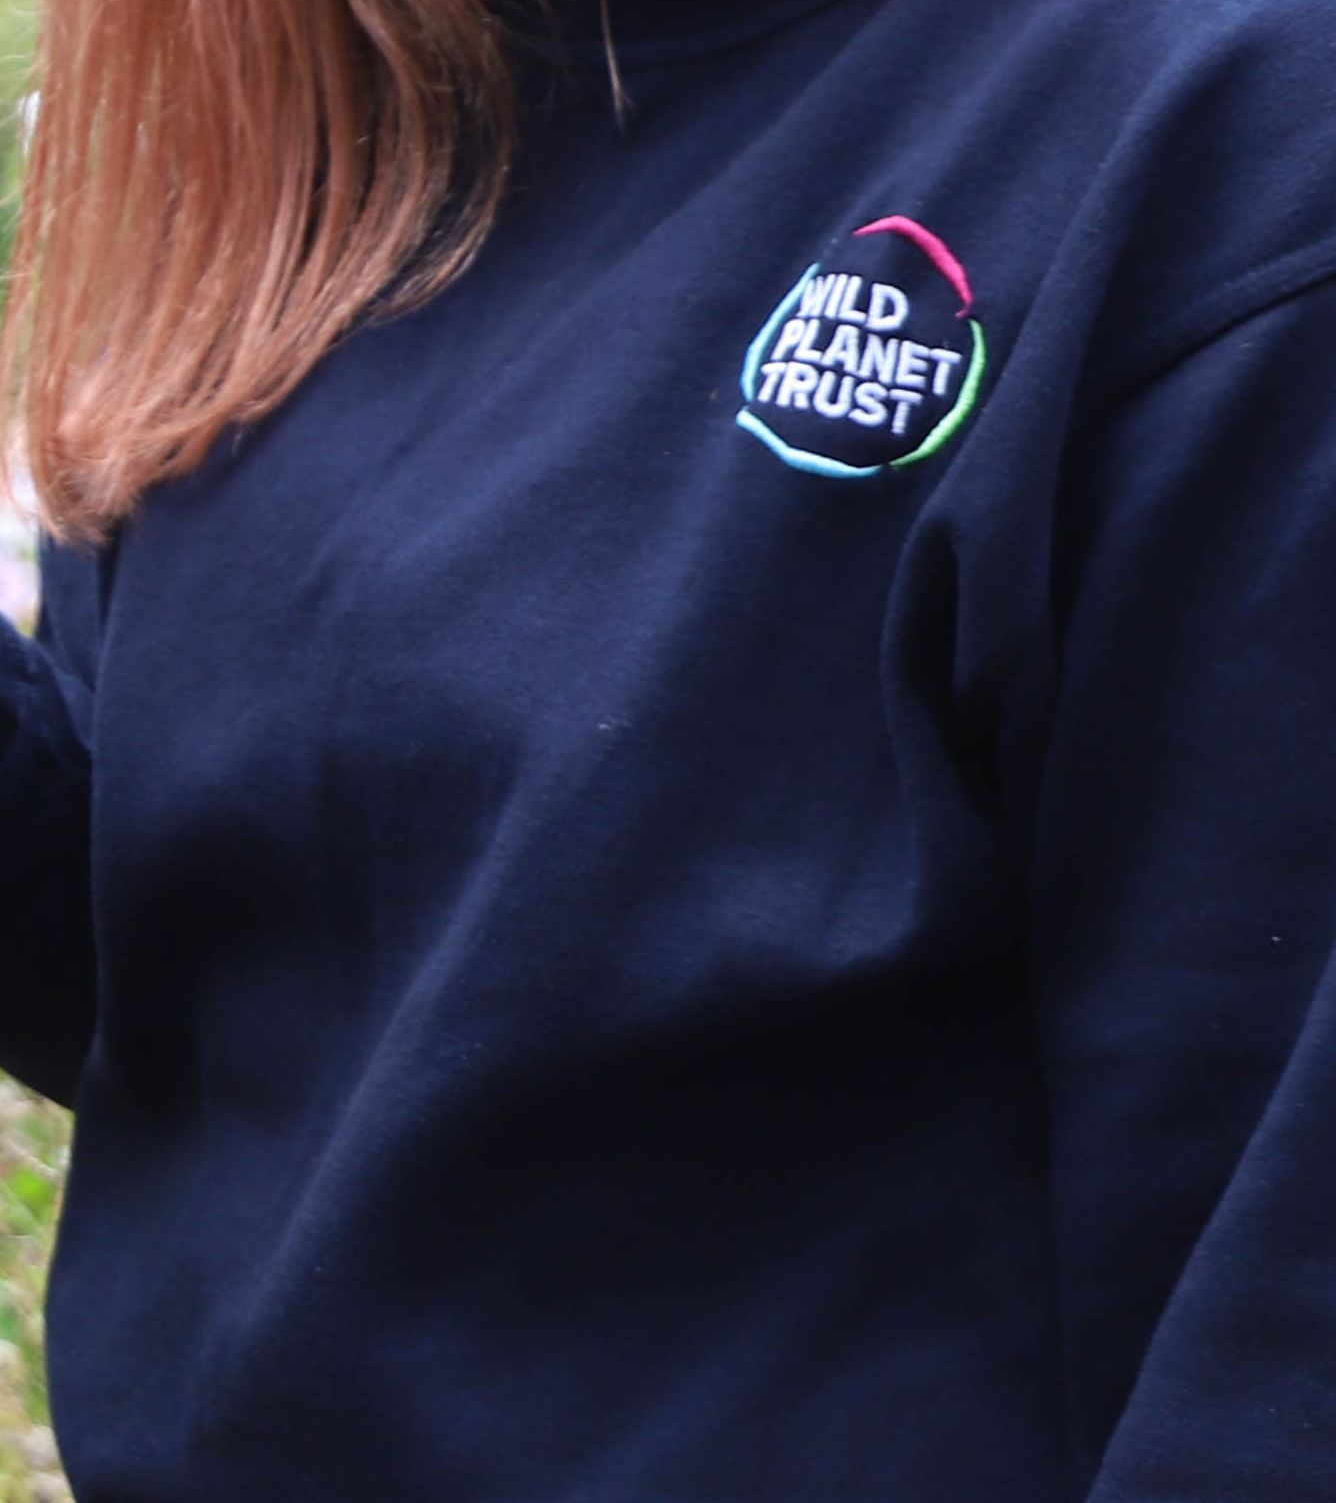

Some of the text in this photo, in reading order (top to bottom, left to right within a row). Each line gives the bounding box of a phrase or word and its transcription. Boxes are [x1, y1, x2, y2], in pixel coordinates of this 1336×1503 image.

[795, 273, 910, 331] WILD
[770, 318, 963, 395] PLANET
[756, 361, 924, 434] TRUST
